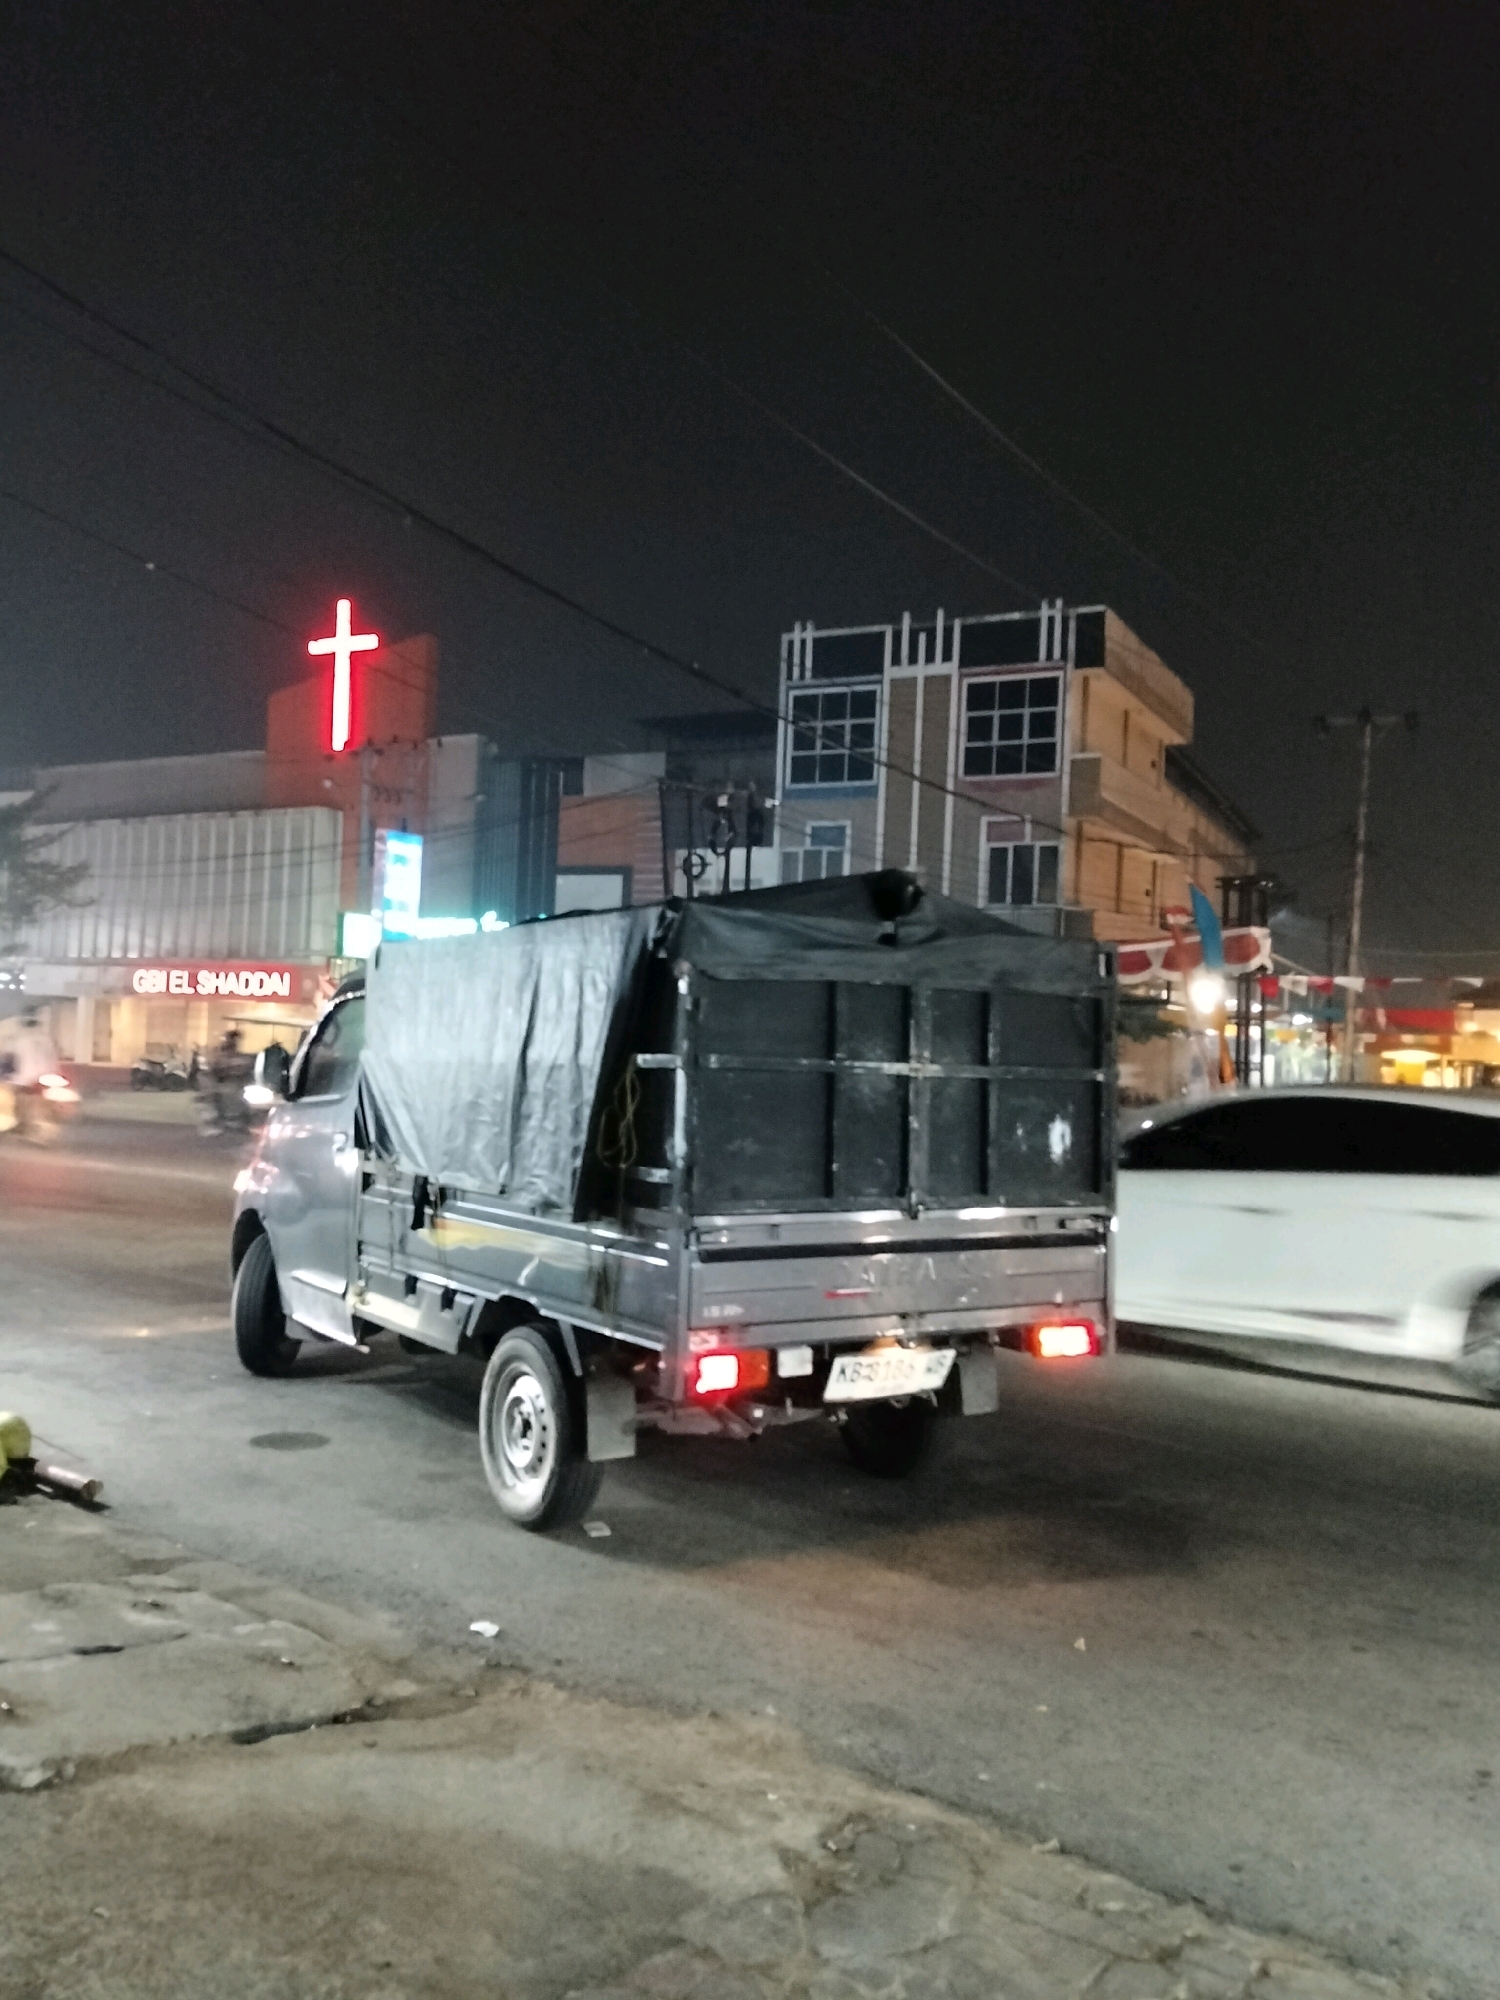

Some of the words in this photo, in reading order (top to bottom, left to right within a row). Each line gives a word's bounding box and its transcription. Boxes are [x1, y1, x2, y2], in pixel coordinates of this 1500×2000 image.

[132, 968, 168, 994] GBI
[168, 969, 196, 995] EL
[196, 969, 291, 997] SHADDAI
